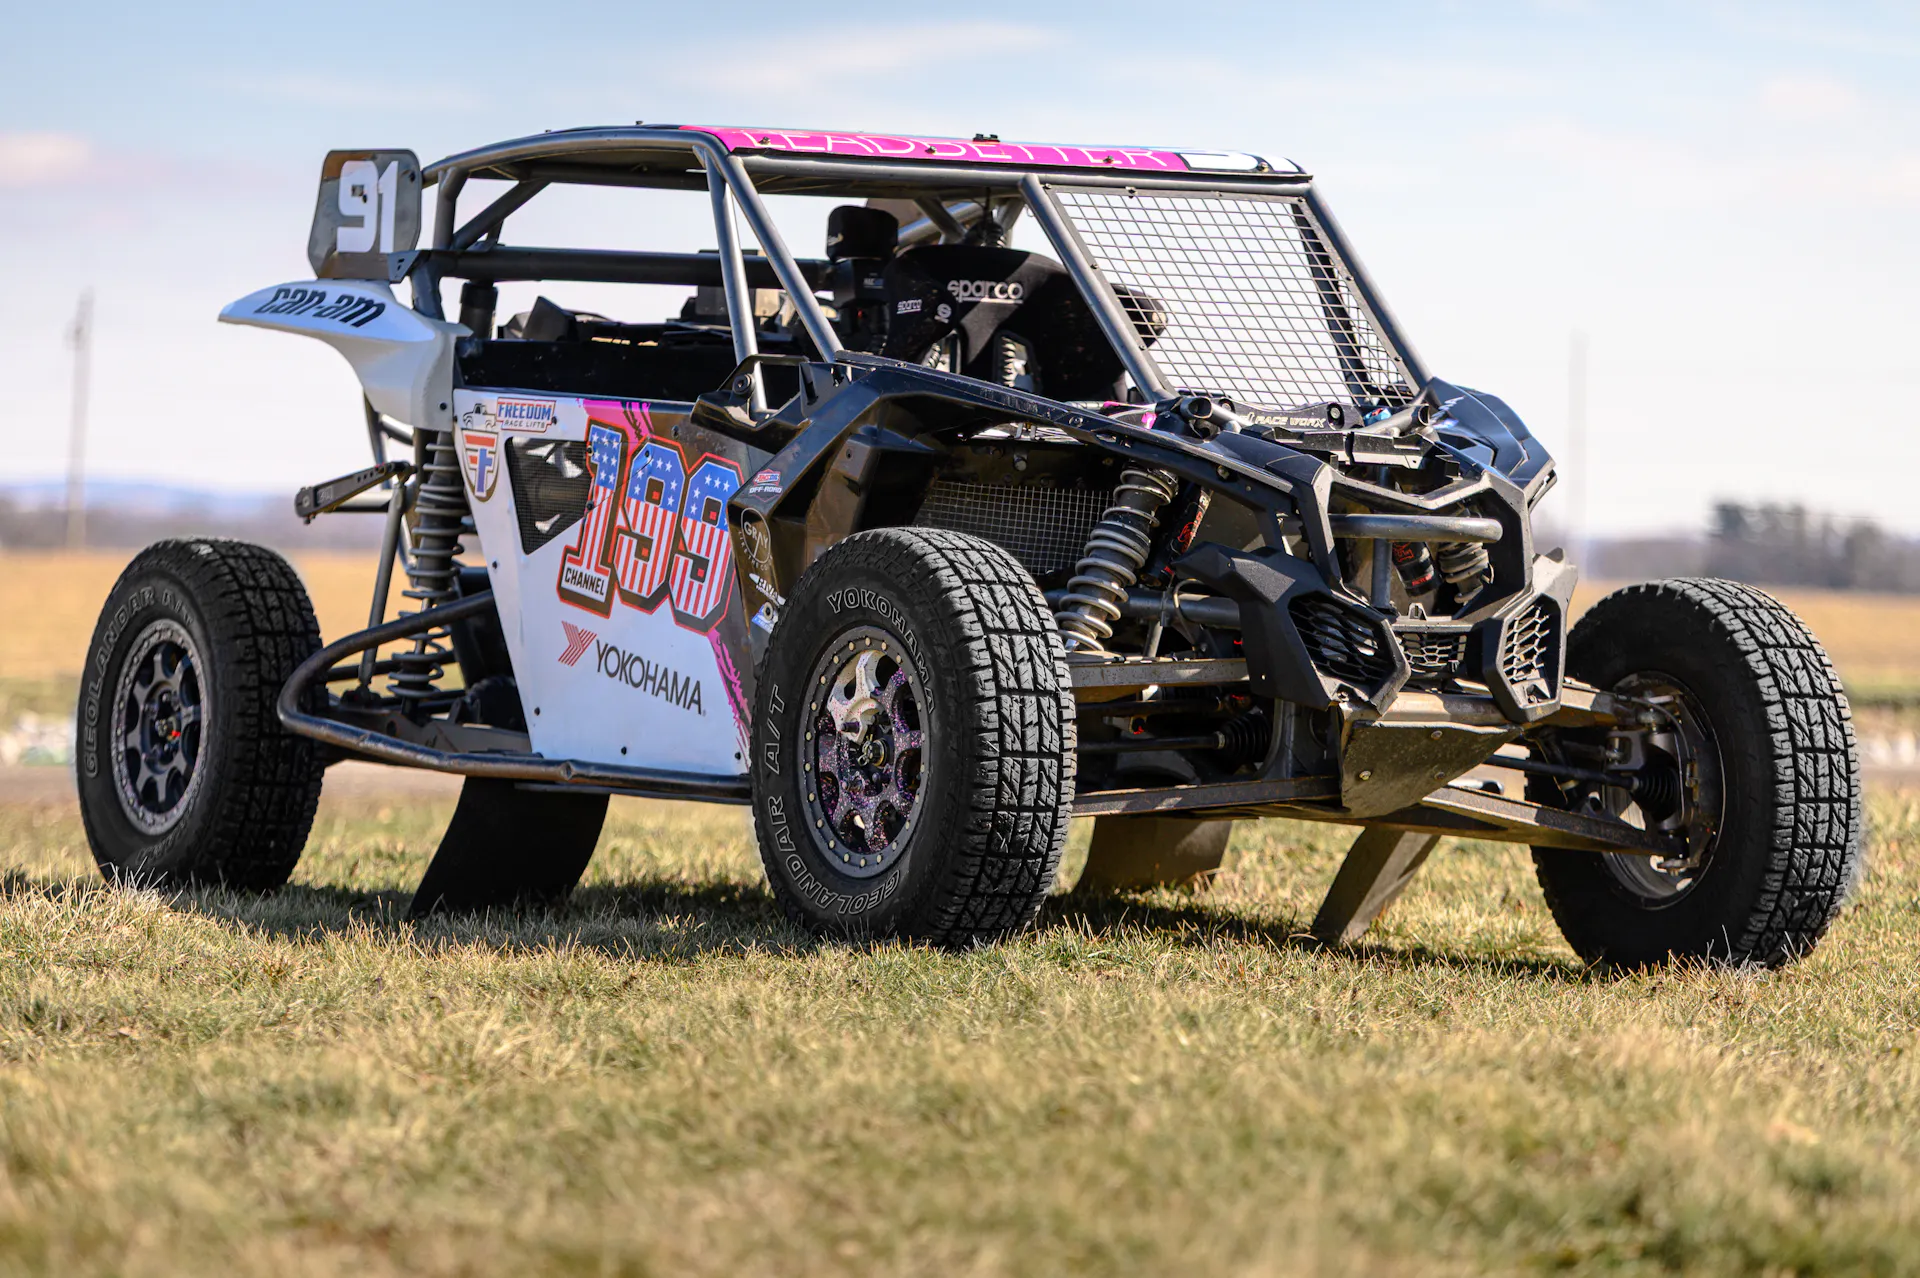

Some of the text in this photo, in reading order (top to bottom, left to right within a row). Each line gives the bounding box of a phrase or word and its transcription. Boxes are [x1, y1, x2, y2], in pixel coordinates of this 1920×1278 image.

[741, 129, 1167, 167] LEADBETTER
[336, 160, 399, 254] 91
[897, 299, 922, 312] sparco
[947, 279, 1024, 302] sparco
[498, 402, 552, 420] FREEDOM
[526, 421, 545, 429] LIFTS
[749, 486, 783, 494] OFF-ROAD
[562, 421, 738, 625] 199
[743, 521, 769, 556] GRAY
[564, 567, 605, 596] CHANNEL
[827, 587, 935, 714] YOKOHAMA
[84, 586, 156, 779] GEOLANDAR
[596, 638, 702, 715] YOKOHAMA
[765, 684, 900, 915] GEOLANDAR A/T
